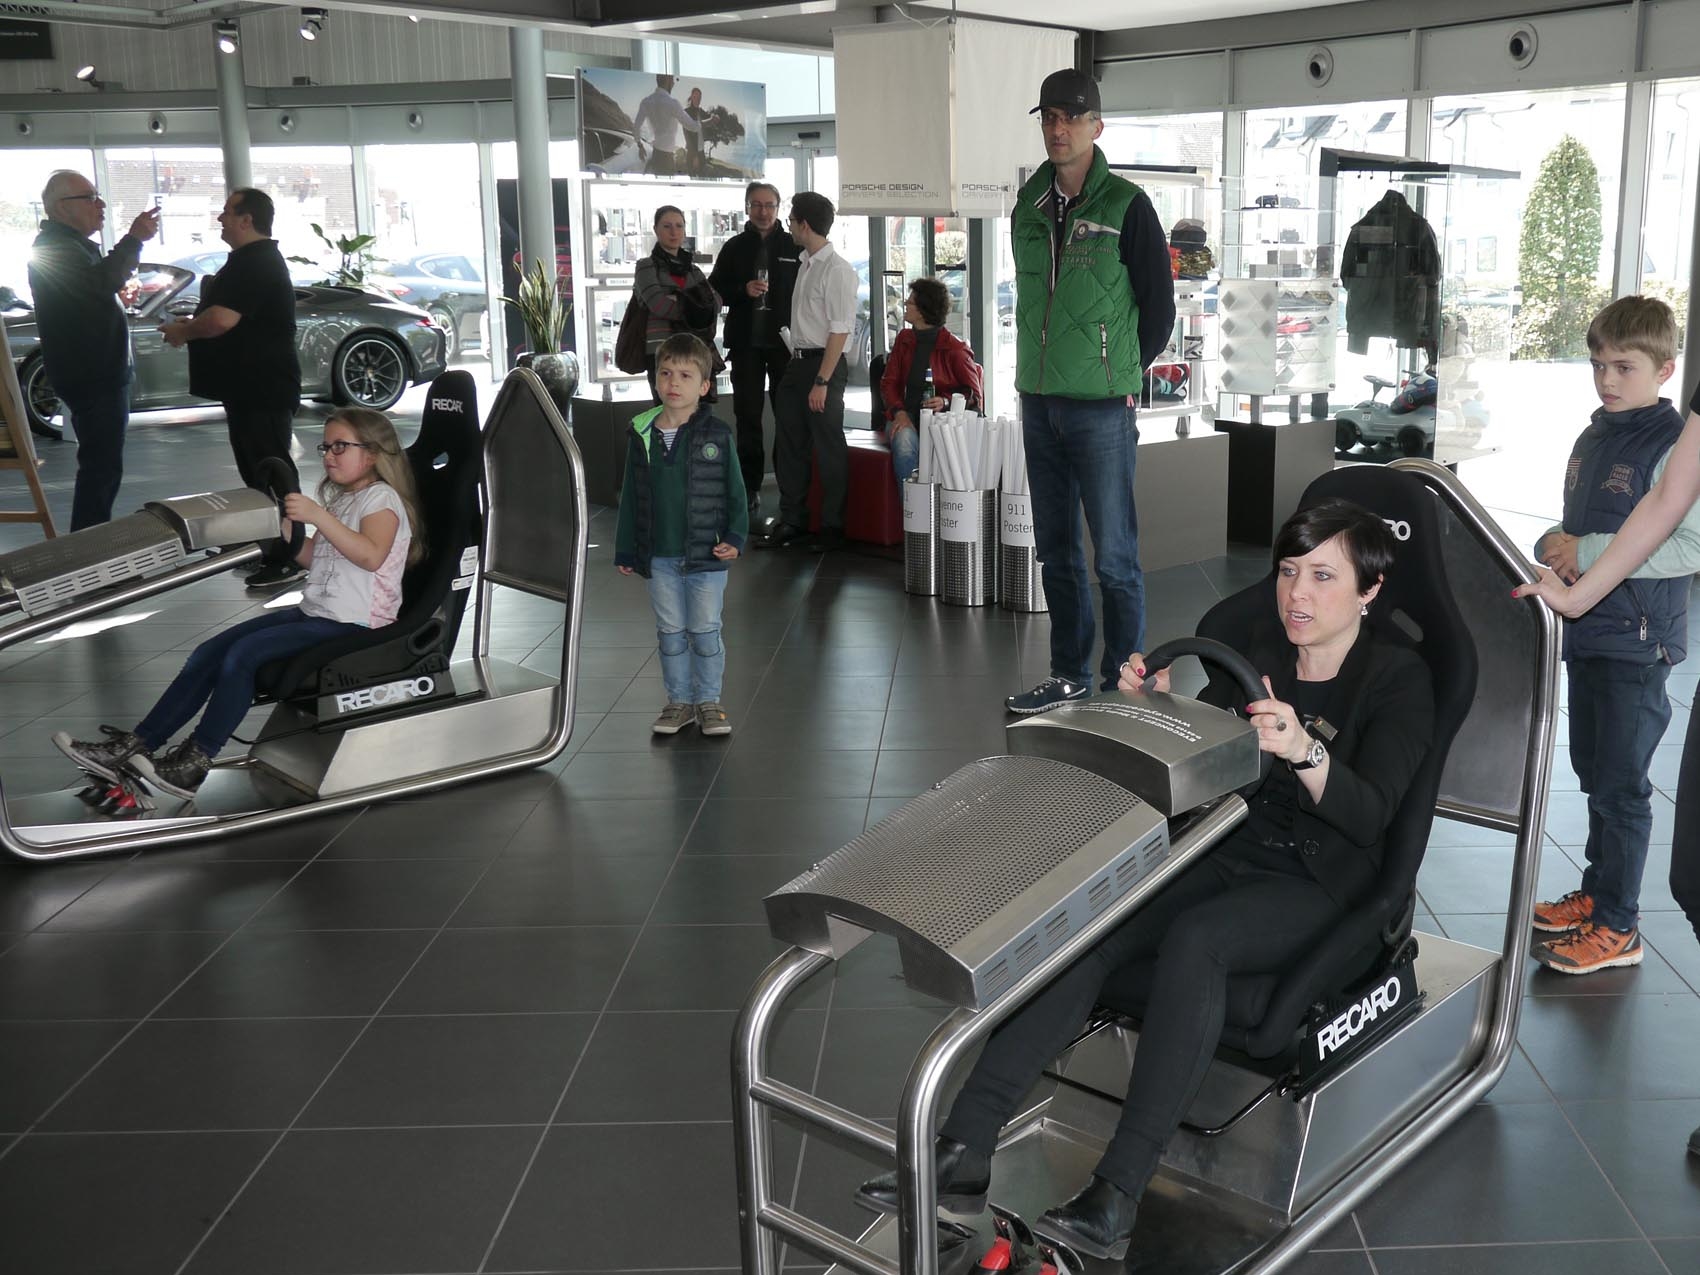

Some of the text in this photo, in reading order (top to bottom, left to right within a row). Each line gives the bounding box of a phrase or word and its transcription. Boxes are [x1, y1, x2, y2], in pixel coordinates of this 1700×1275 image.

[842, 183, 924, 191] PORSCHE DESIGN
[1007, 503, 1026, 516] 911
[941, 518, 959, 529] ster
[1003, 519, 1034, 534] Poster
[335, 676, 435, 713] RECARO
[1317, 976, 1401, 1061] RECARO
